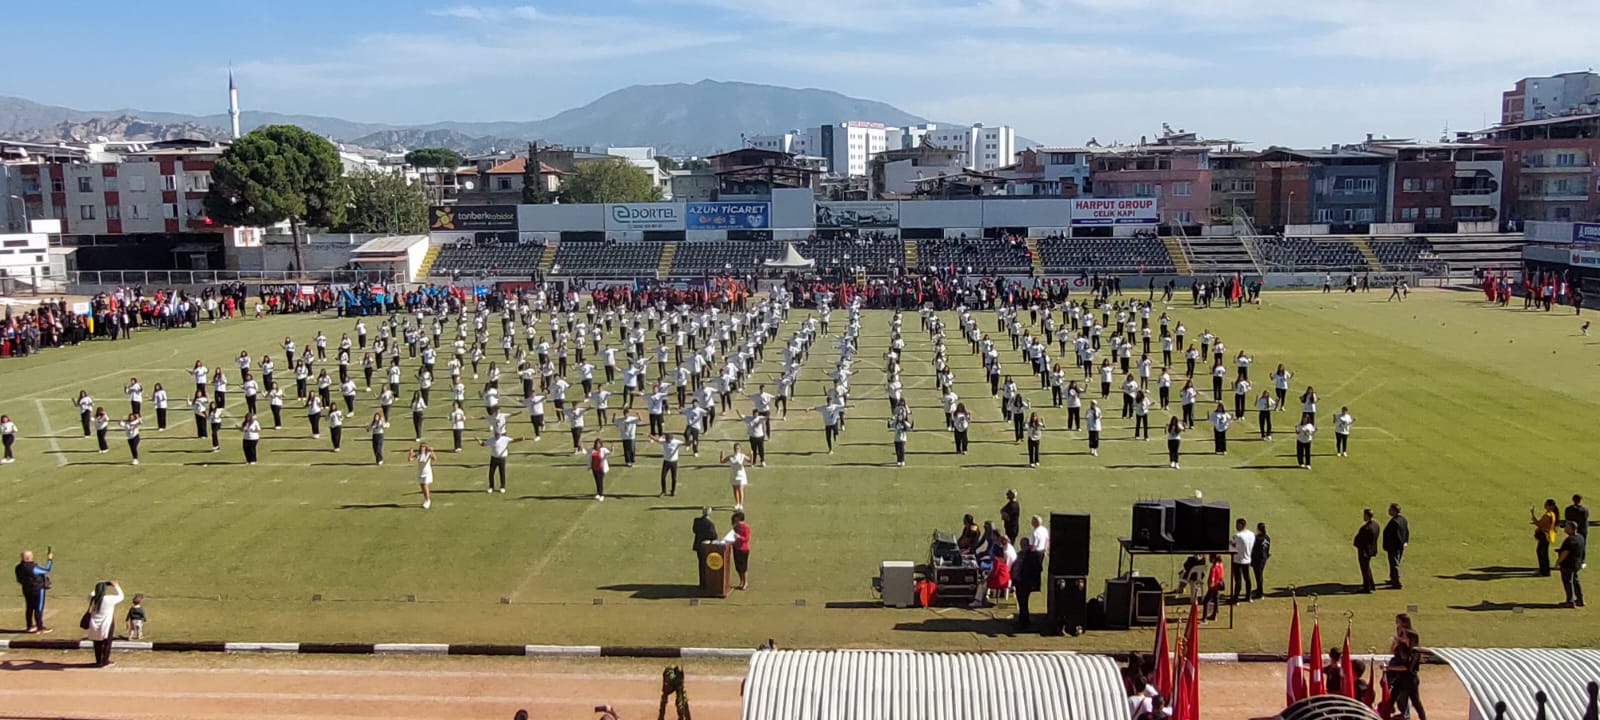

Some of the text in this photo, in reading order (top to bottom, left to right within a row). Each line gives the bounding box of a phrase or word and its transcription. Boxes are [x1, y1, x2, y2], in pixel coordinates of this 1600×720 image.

[689, 204, 765, 214] AZUN TİCARET
[1076, 200, 1152, 209] HARPUT GROUP
